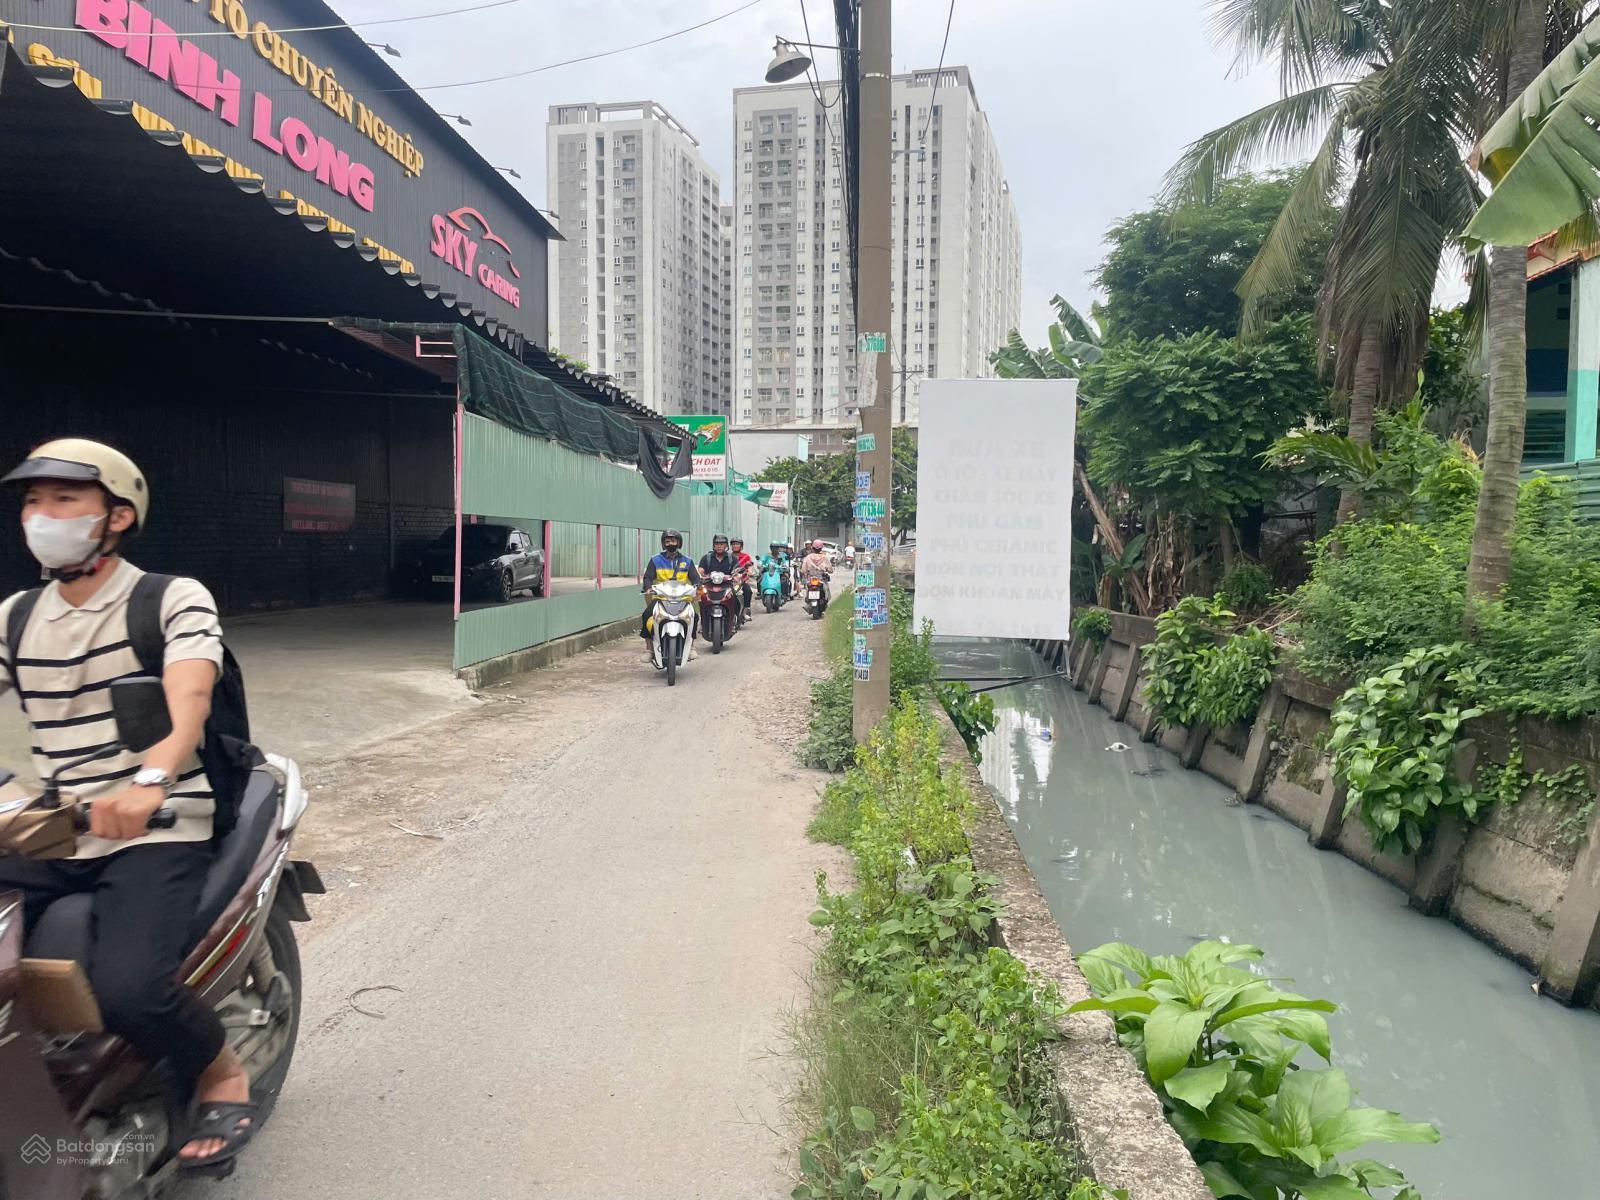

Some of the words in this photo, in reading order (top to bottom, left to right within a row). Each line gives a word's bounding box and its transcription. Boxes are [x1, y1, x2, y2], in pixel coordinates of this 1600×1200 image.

[252, 22, 353, 123] CHUYÊN
[357, 102, 424, 178] NGHIỆP
[252, 92, 375, 212] LONG
[430, 214, 478, 278] SKY
[477, 263, 520, 309] CARING
[974, 538, 1057, 554] CERAMIC
